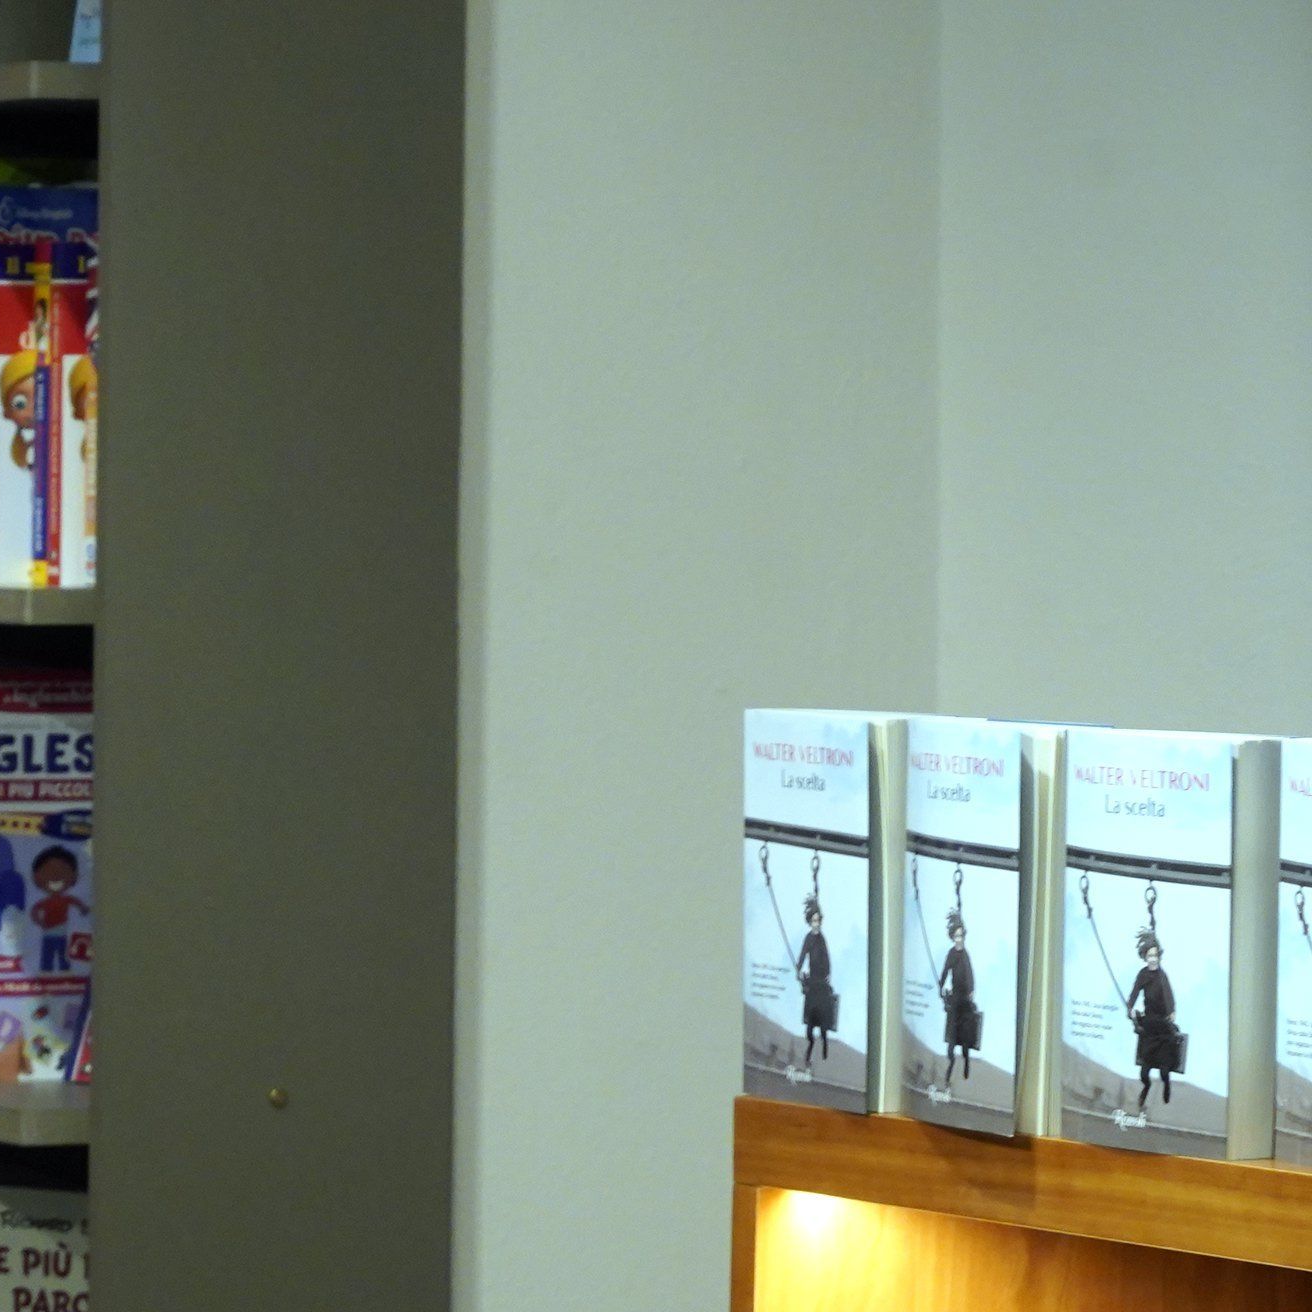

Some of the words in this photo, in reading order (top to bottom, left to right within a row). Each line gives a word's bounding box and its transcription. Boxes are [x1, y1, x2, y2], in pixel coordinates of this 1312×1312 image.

[1074, 765, 1125, 787] WALTER
[1129, 768, 1211, 792] VELTRONI
[1289, 775, 1312, 797] WAL
[1104, 794, 1121, 815] La
[1125, 797, 1167, 818] scelta
[21, 1241, 73, 1279] PIÙ
